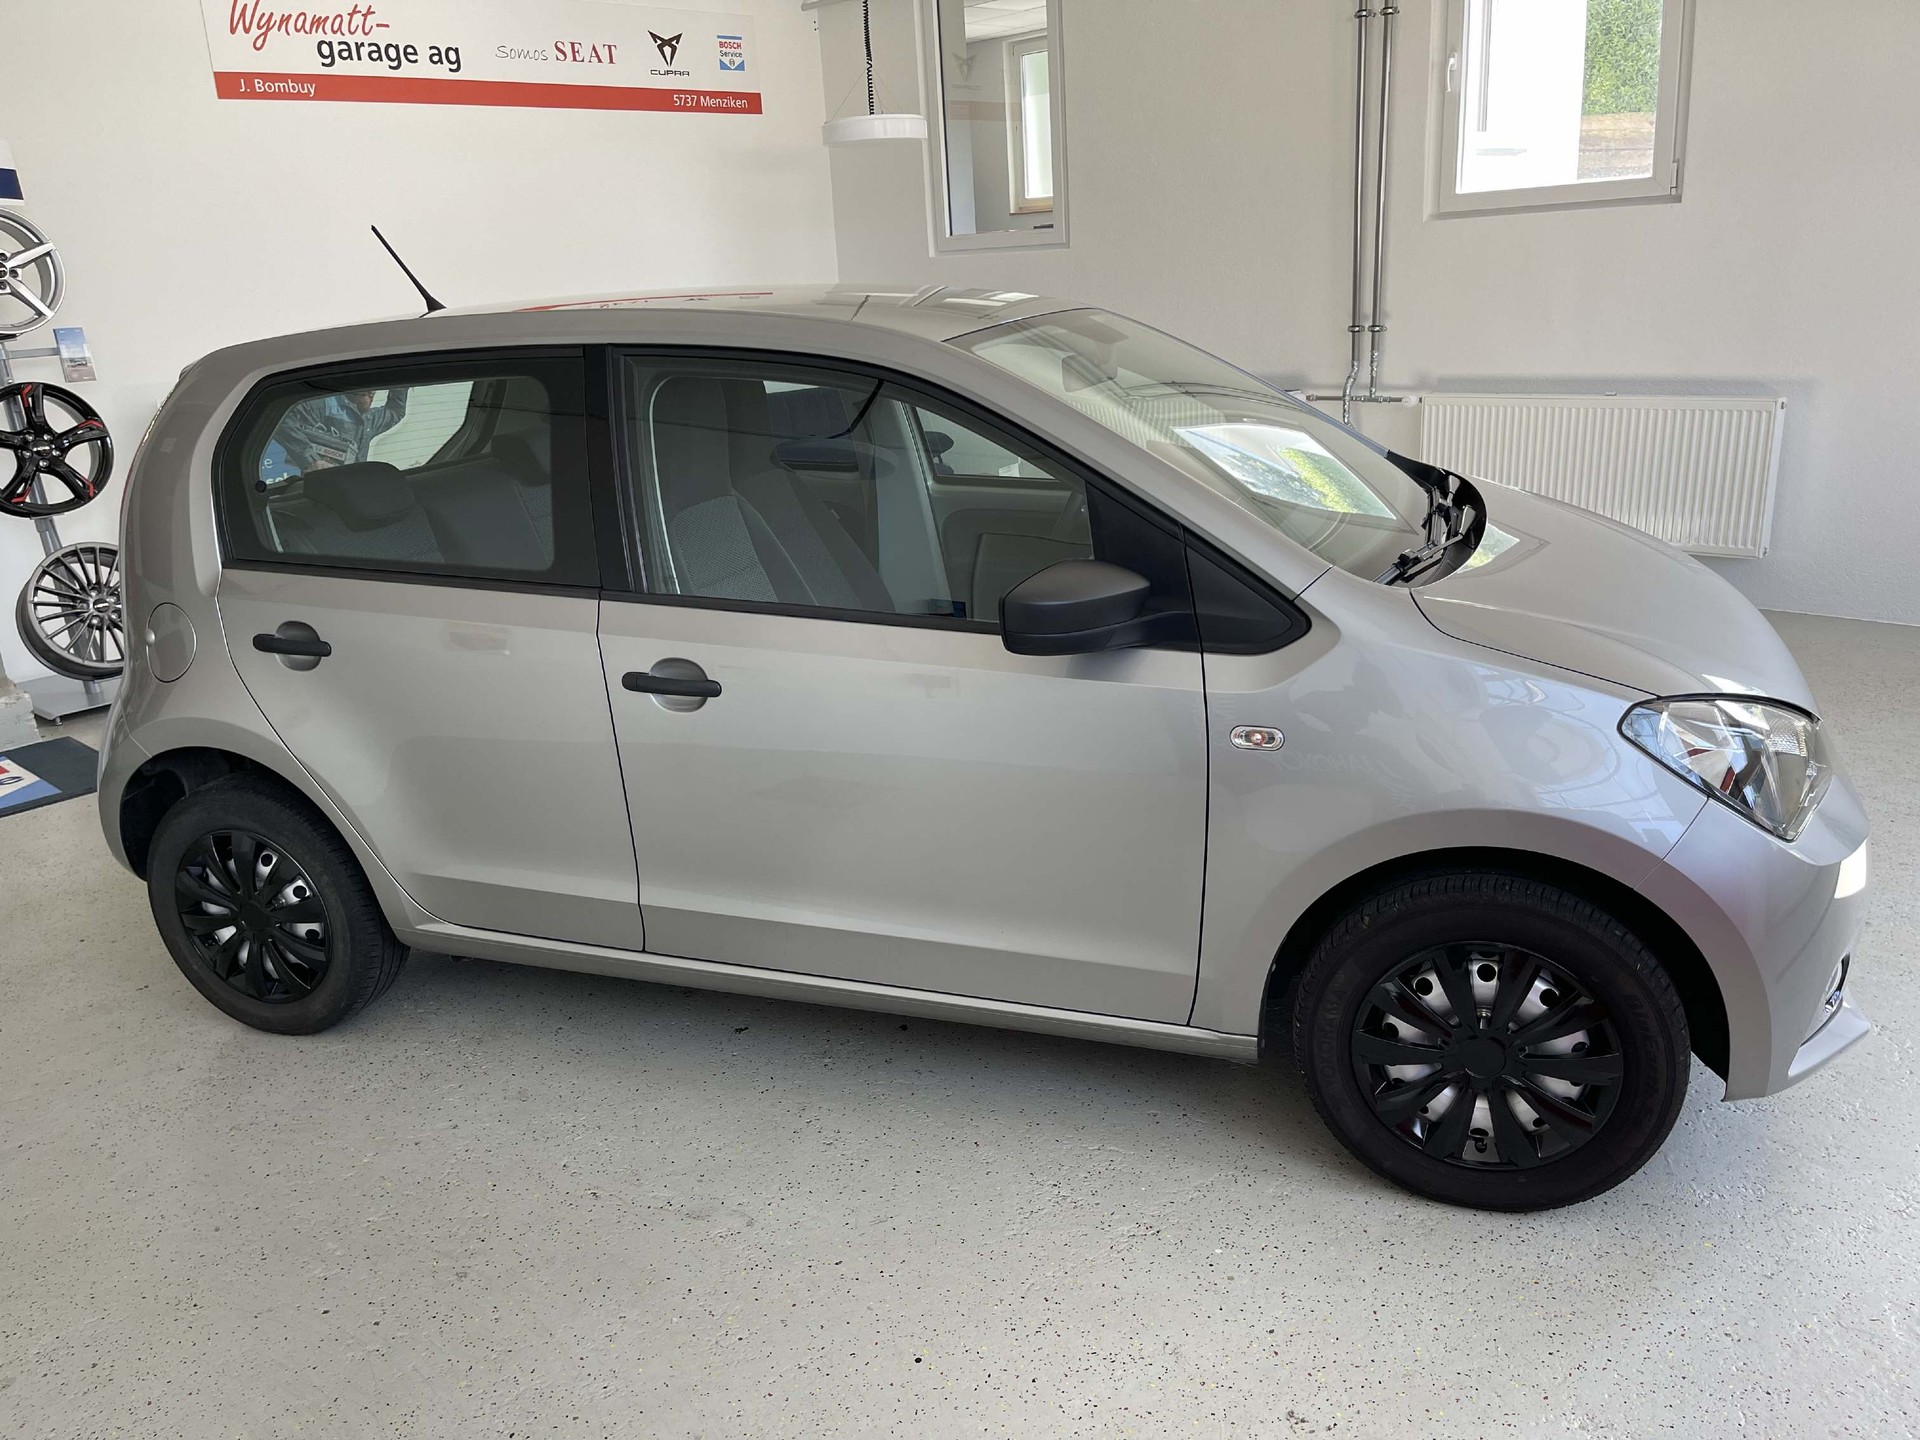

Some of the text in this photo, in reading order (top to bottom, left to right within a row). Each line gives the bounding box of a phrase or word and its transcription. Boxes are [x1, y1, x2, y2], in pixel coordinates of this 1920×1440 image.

[229, 0, 390, 51] Wynamatt-
[495, 39, 618, 65] Somos SEAT
[718, 40, 742, 50] BOSCH
[316, 38, 462, 73] garage ag
[719, 50, 743, 59] Service
[650, 69, 690, 77] CUPRA
[238, 78, 317, 97] J. Bombuy
[673, 94, 749, 109] 5737 Menziken
